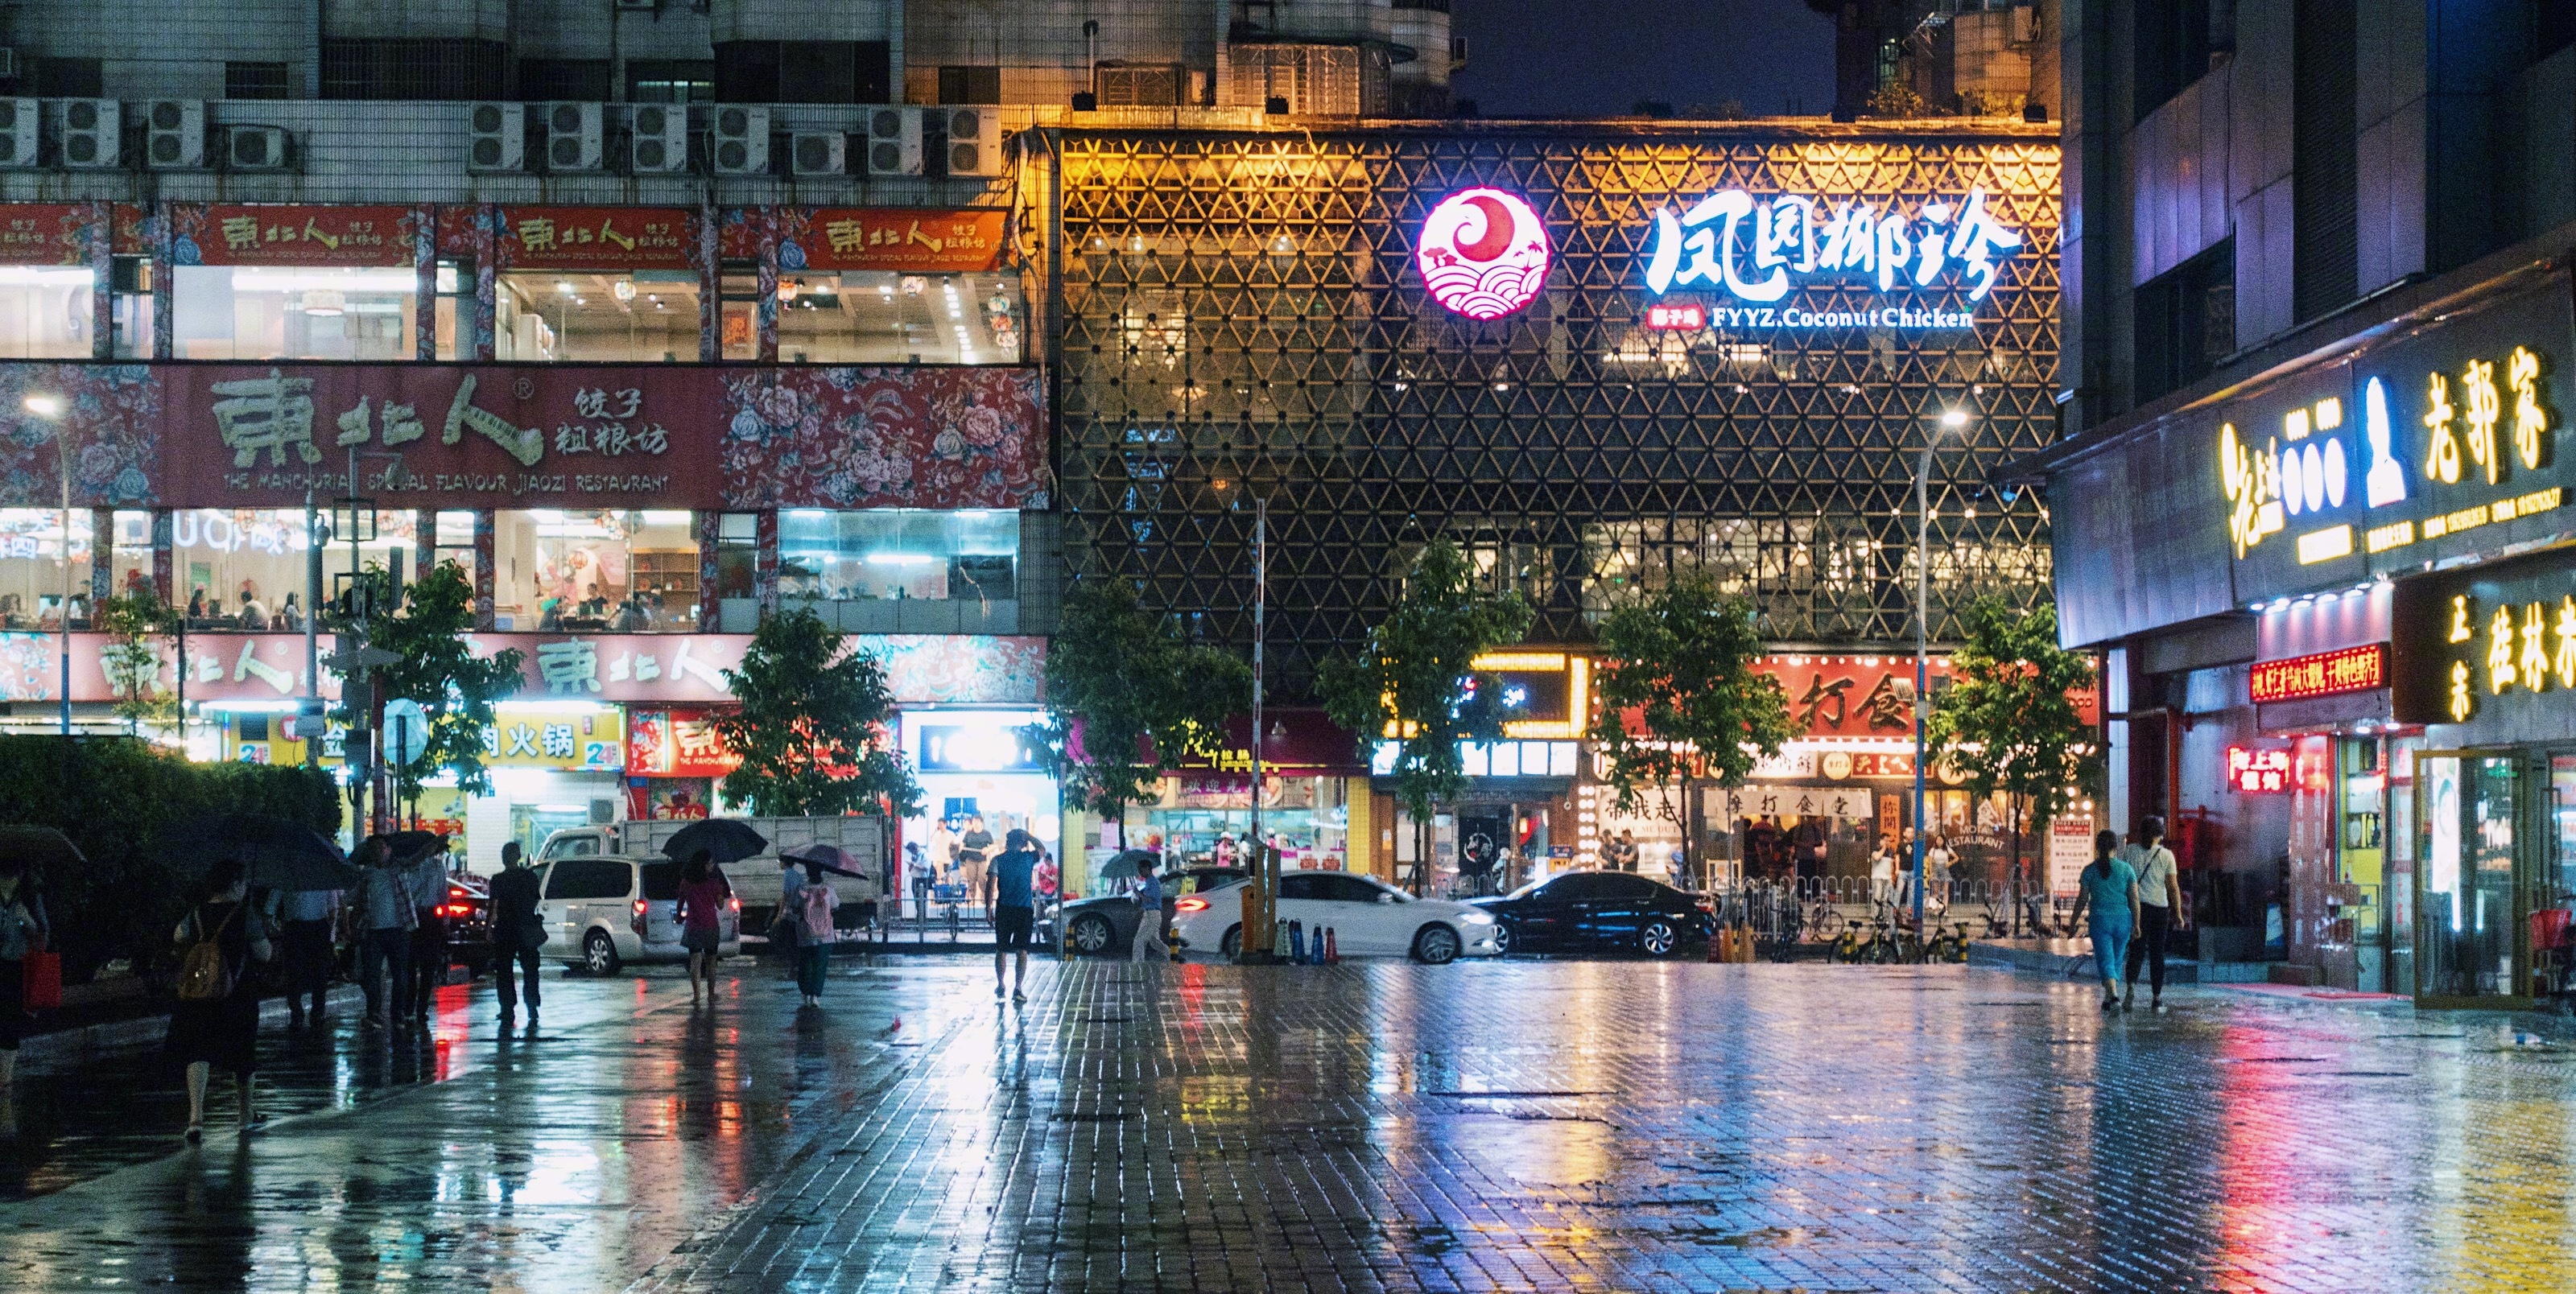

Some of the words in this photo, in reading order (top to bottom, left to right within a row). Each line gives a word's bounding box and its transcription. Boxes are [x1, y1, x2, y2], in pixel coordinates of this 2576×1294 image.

[1880, 307, 1973, 328] Chicken
[574, 386, 642, 418] 饺子
[555, 422, 670, 456] 粗粮坊
[258, 473, 357, 490] MANCHURIA
[435, 473, 507, 492] FLAVOUR
[513, 473, 566, 497] JIAOZI
[575, 474, 669, 492] RESTAURANT
[587, 743, 615, 764] 24
[1947, 835, 2005, 851] ESTAURANT
